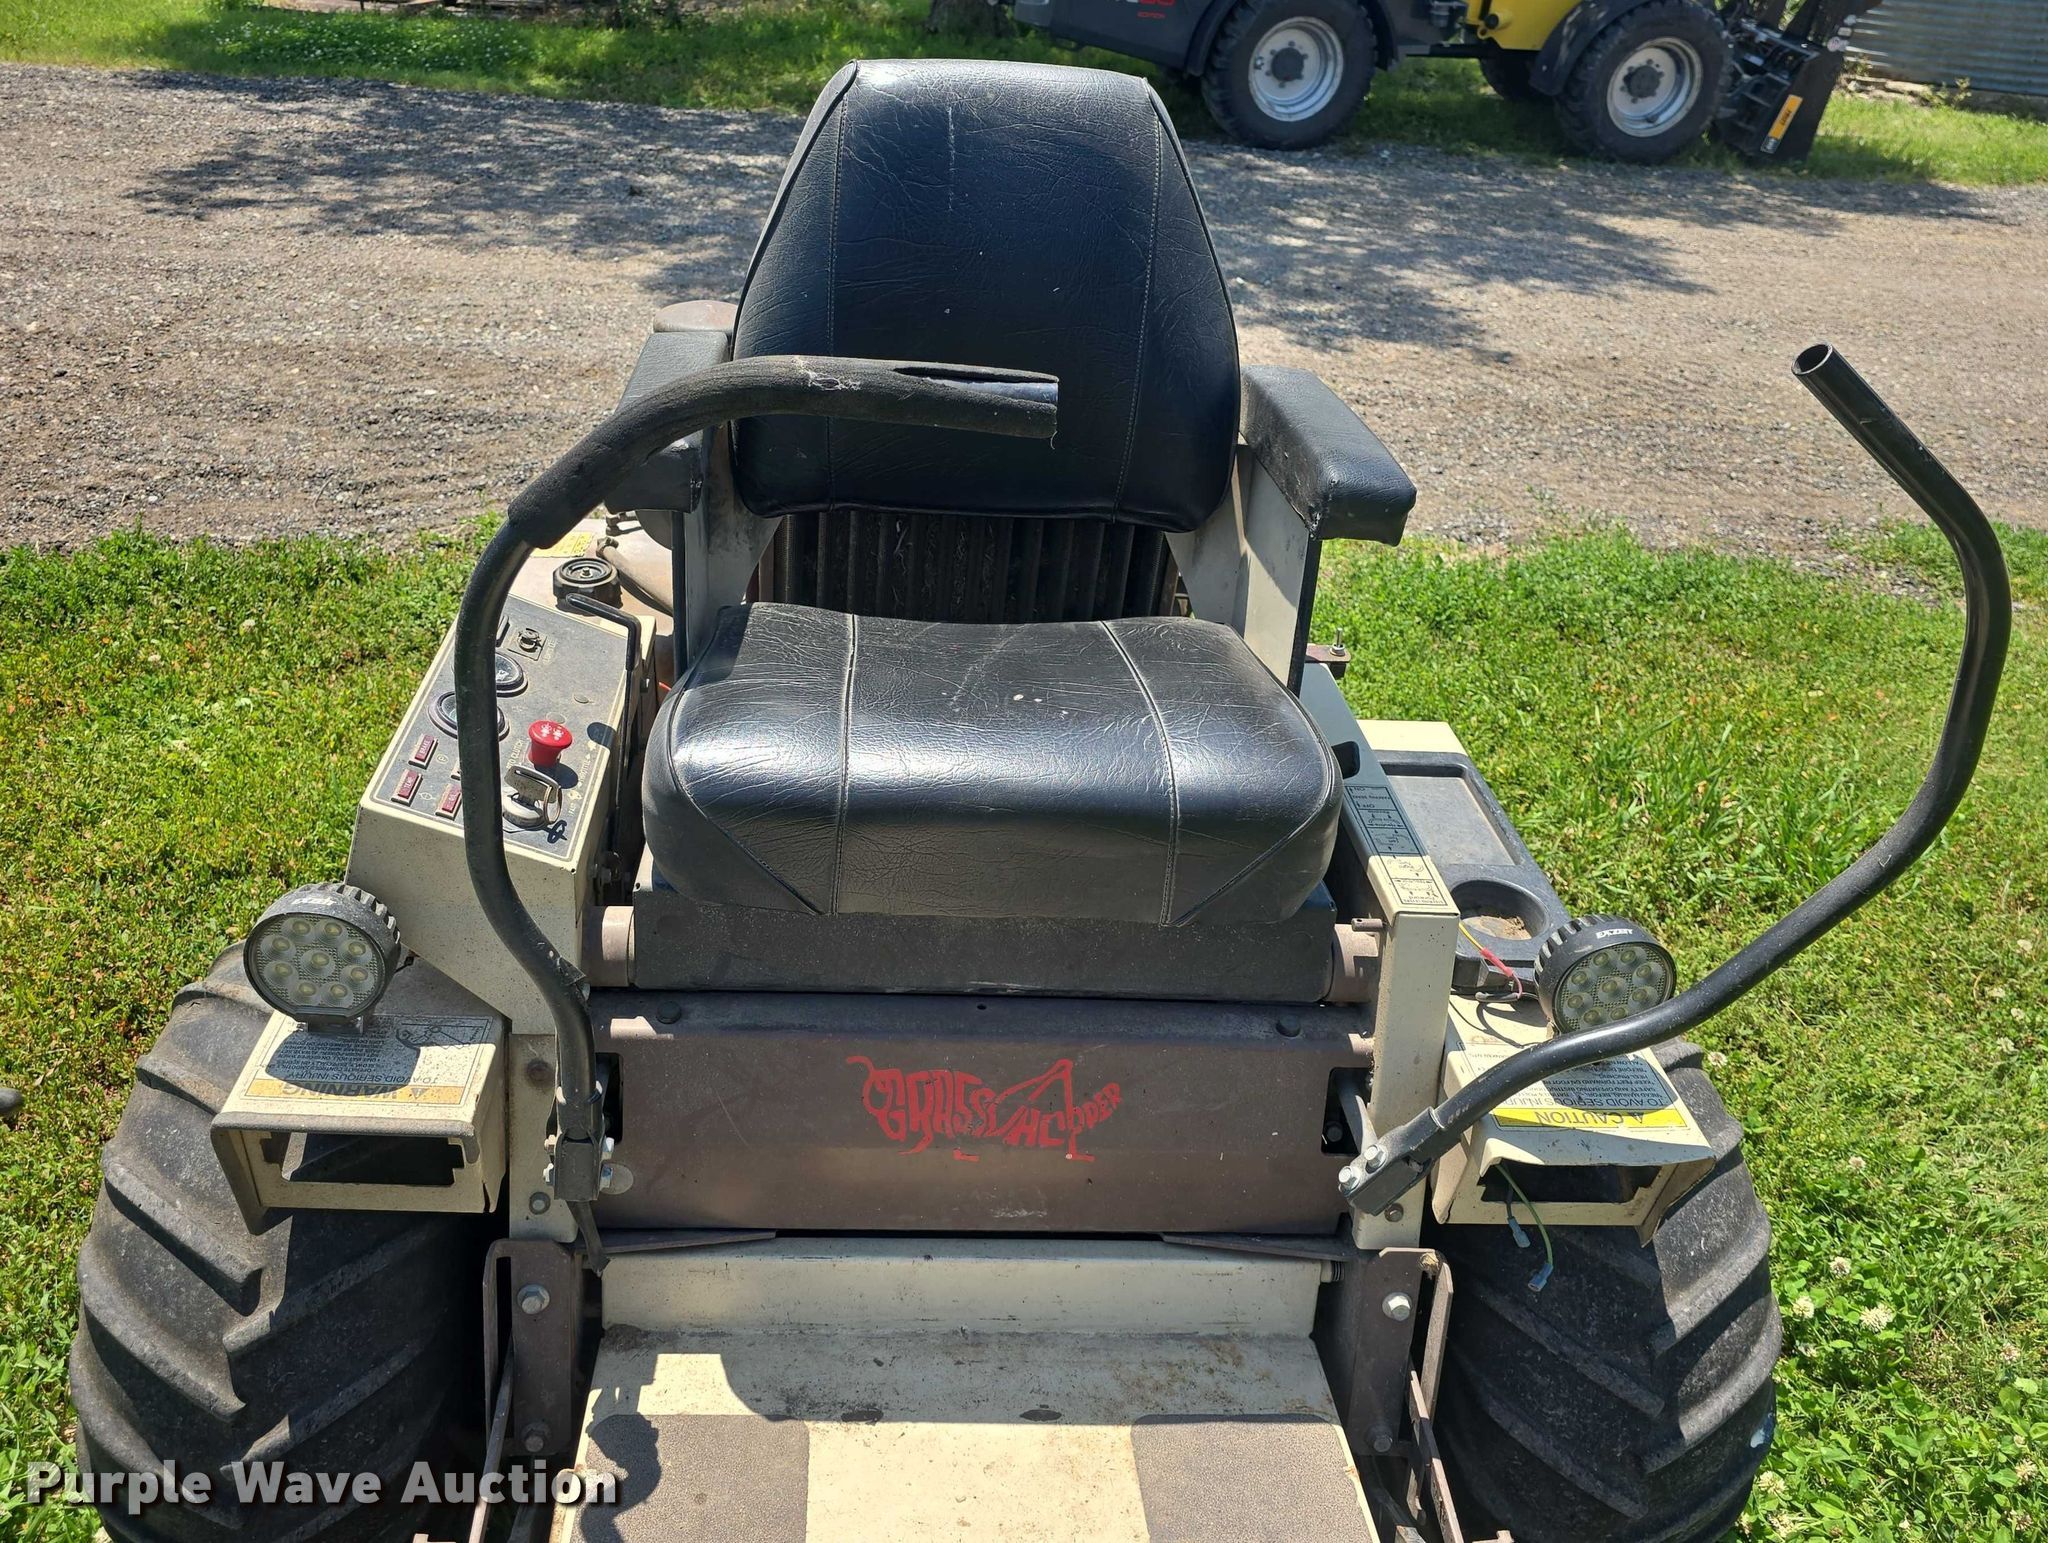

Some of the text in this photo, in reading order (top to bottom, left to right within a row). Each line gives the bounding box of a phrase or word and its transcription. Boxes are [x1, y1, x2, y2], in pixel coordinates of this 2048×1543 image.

[288, 1072, 329, 1080] INJURY
[331, 1073, 382, 1082] SERIOUS
[386, 1074, 418, 1084] AVOID
[280, 1082, 398, 1099] WARNING
[1501, 1096, 1664, 1107] TO AVOID SERIOUS INJUR
[1534, 1111, 1624, 1124] CAUTION
